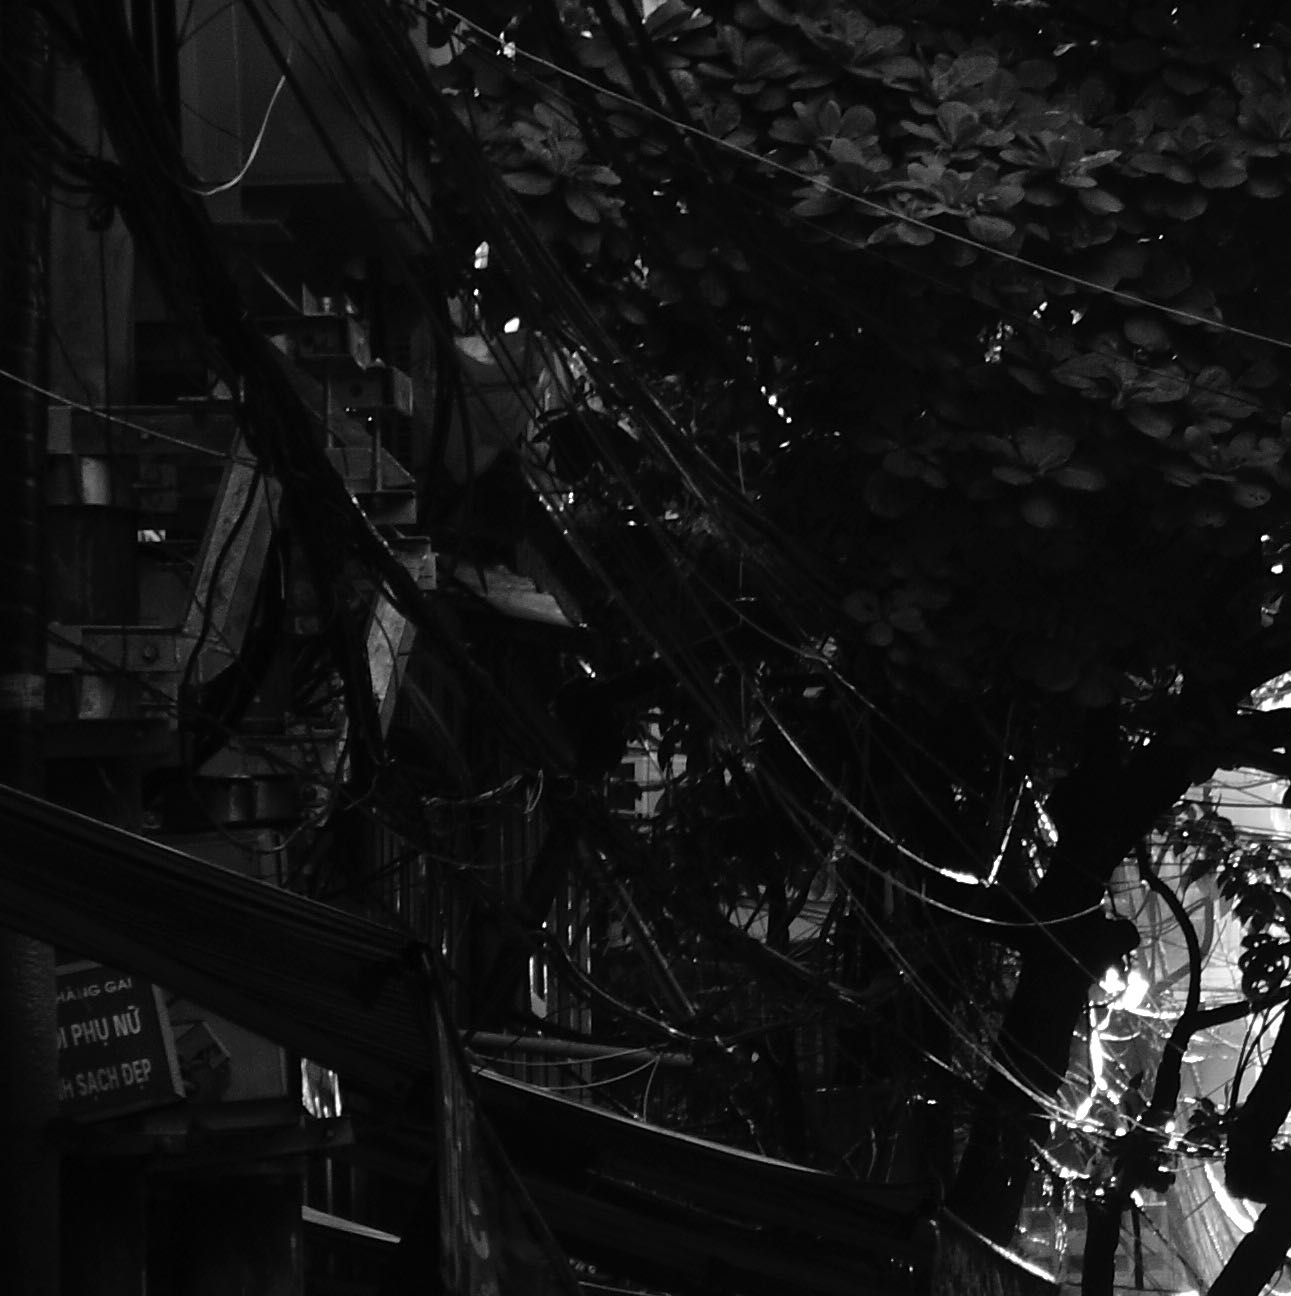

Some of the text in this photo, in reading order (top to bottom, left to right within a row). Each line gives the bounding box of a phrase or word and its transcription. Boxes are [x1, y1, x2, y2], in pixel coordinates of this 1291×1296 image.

[104, 977, 132, 994] GAI
[71, 1017, 109, 1047] PHỤ
[113, 1005, 141, 1037] NỮ
[76, 1065, 120, 1101] SẠCH
